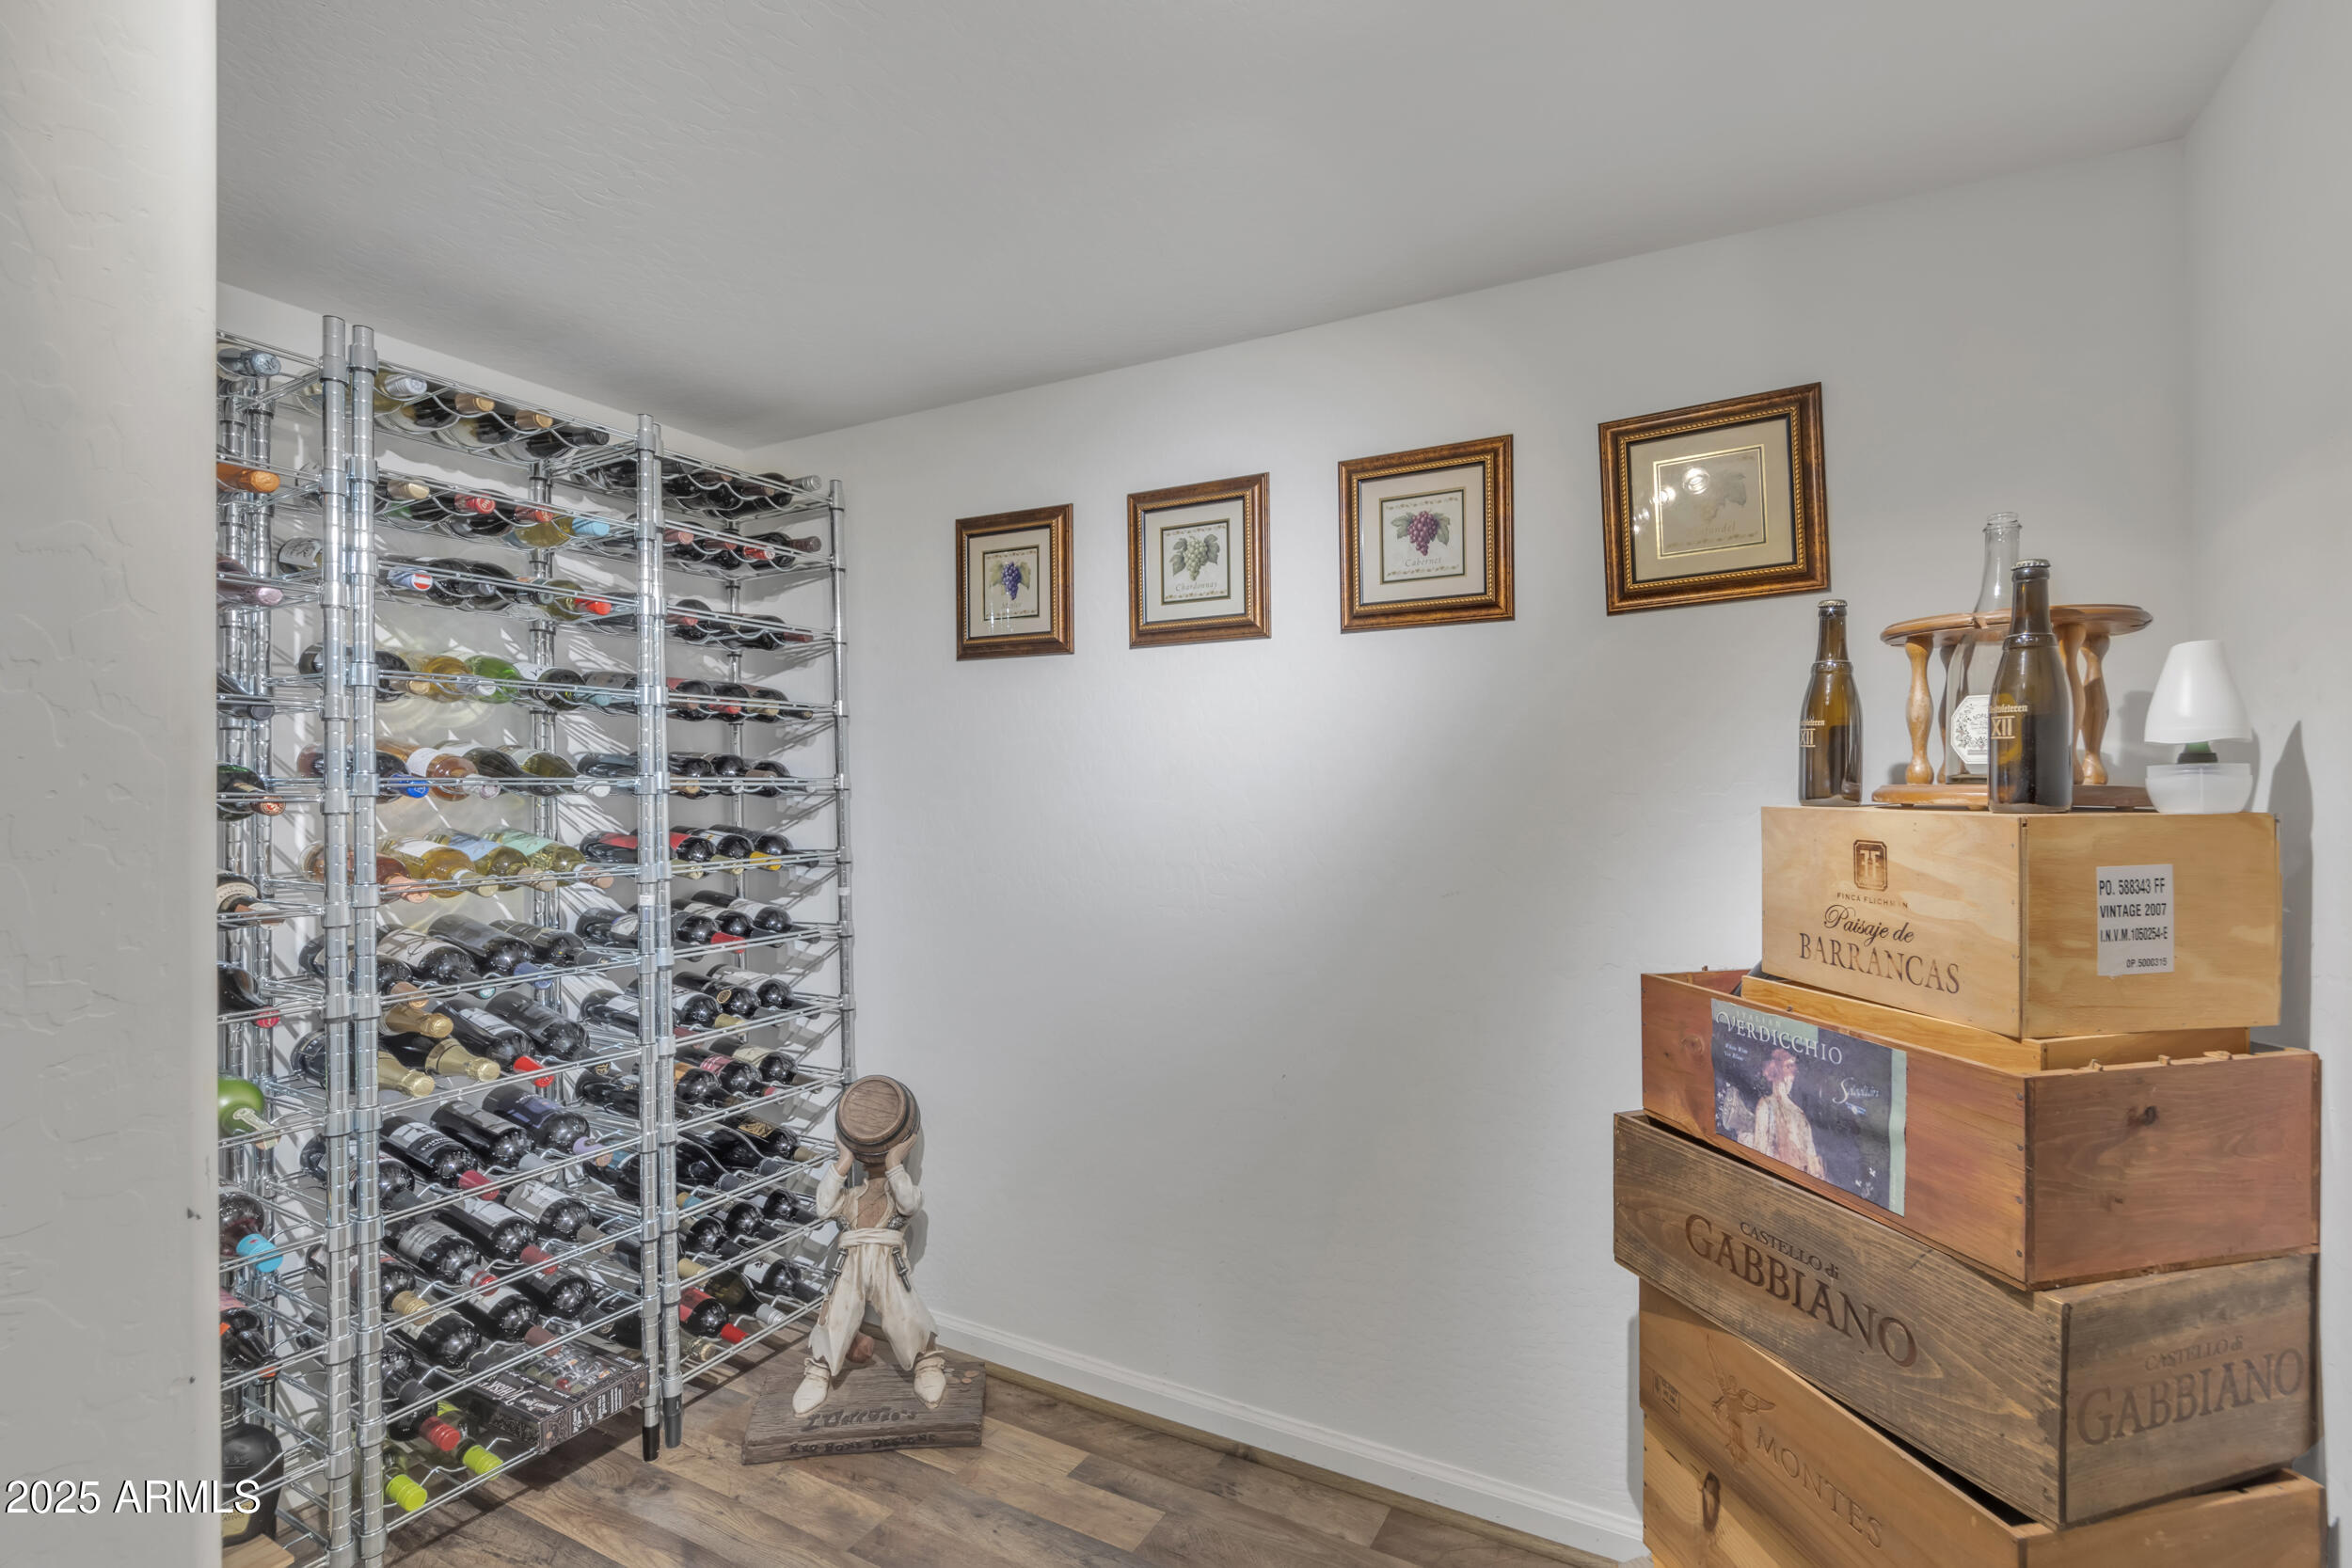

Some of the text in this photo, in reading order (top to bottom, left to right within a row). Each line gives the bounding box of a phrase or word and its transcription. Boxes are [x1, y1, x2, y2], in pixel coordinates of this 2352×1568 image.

[1402, 557, 1442, 567] Cabernet
[1175, 580, 1218, 592] Chardonnay
[1991, 716, 2015, 739] XII
[1836, 892, 1861, 902] FINCA
[2099, 878, 2166, 895] PO. 588343 FF
[1824, 904, 1915, 946] Paisaje de
[2100, 903, 2168, 918] VINTAGE 2007
[1799, 932, 1961, 994] BARRANCAS
[1716, 1011, 1843, 1065] VERDICCHIO
[1740, 1222, 1839, 1280] CASTELLO di
[1685, 1213, 1917, 1367] GABBIANO
[2145, 1335, 2244, 1371] CASTELLO di
[2076, 1348, 2304, 1446] GABBIANO
[1756, 1426, 1883, 1549] MONTES
